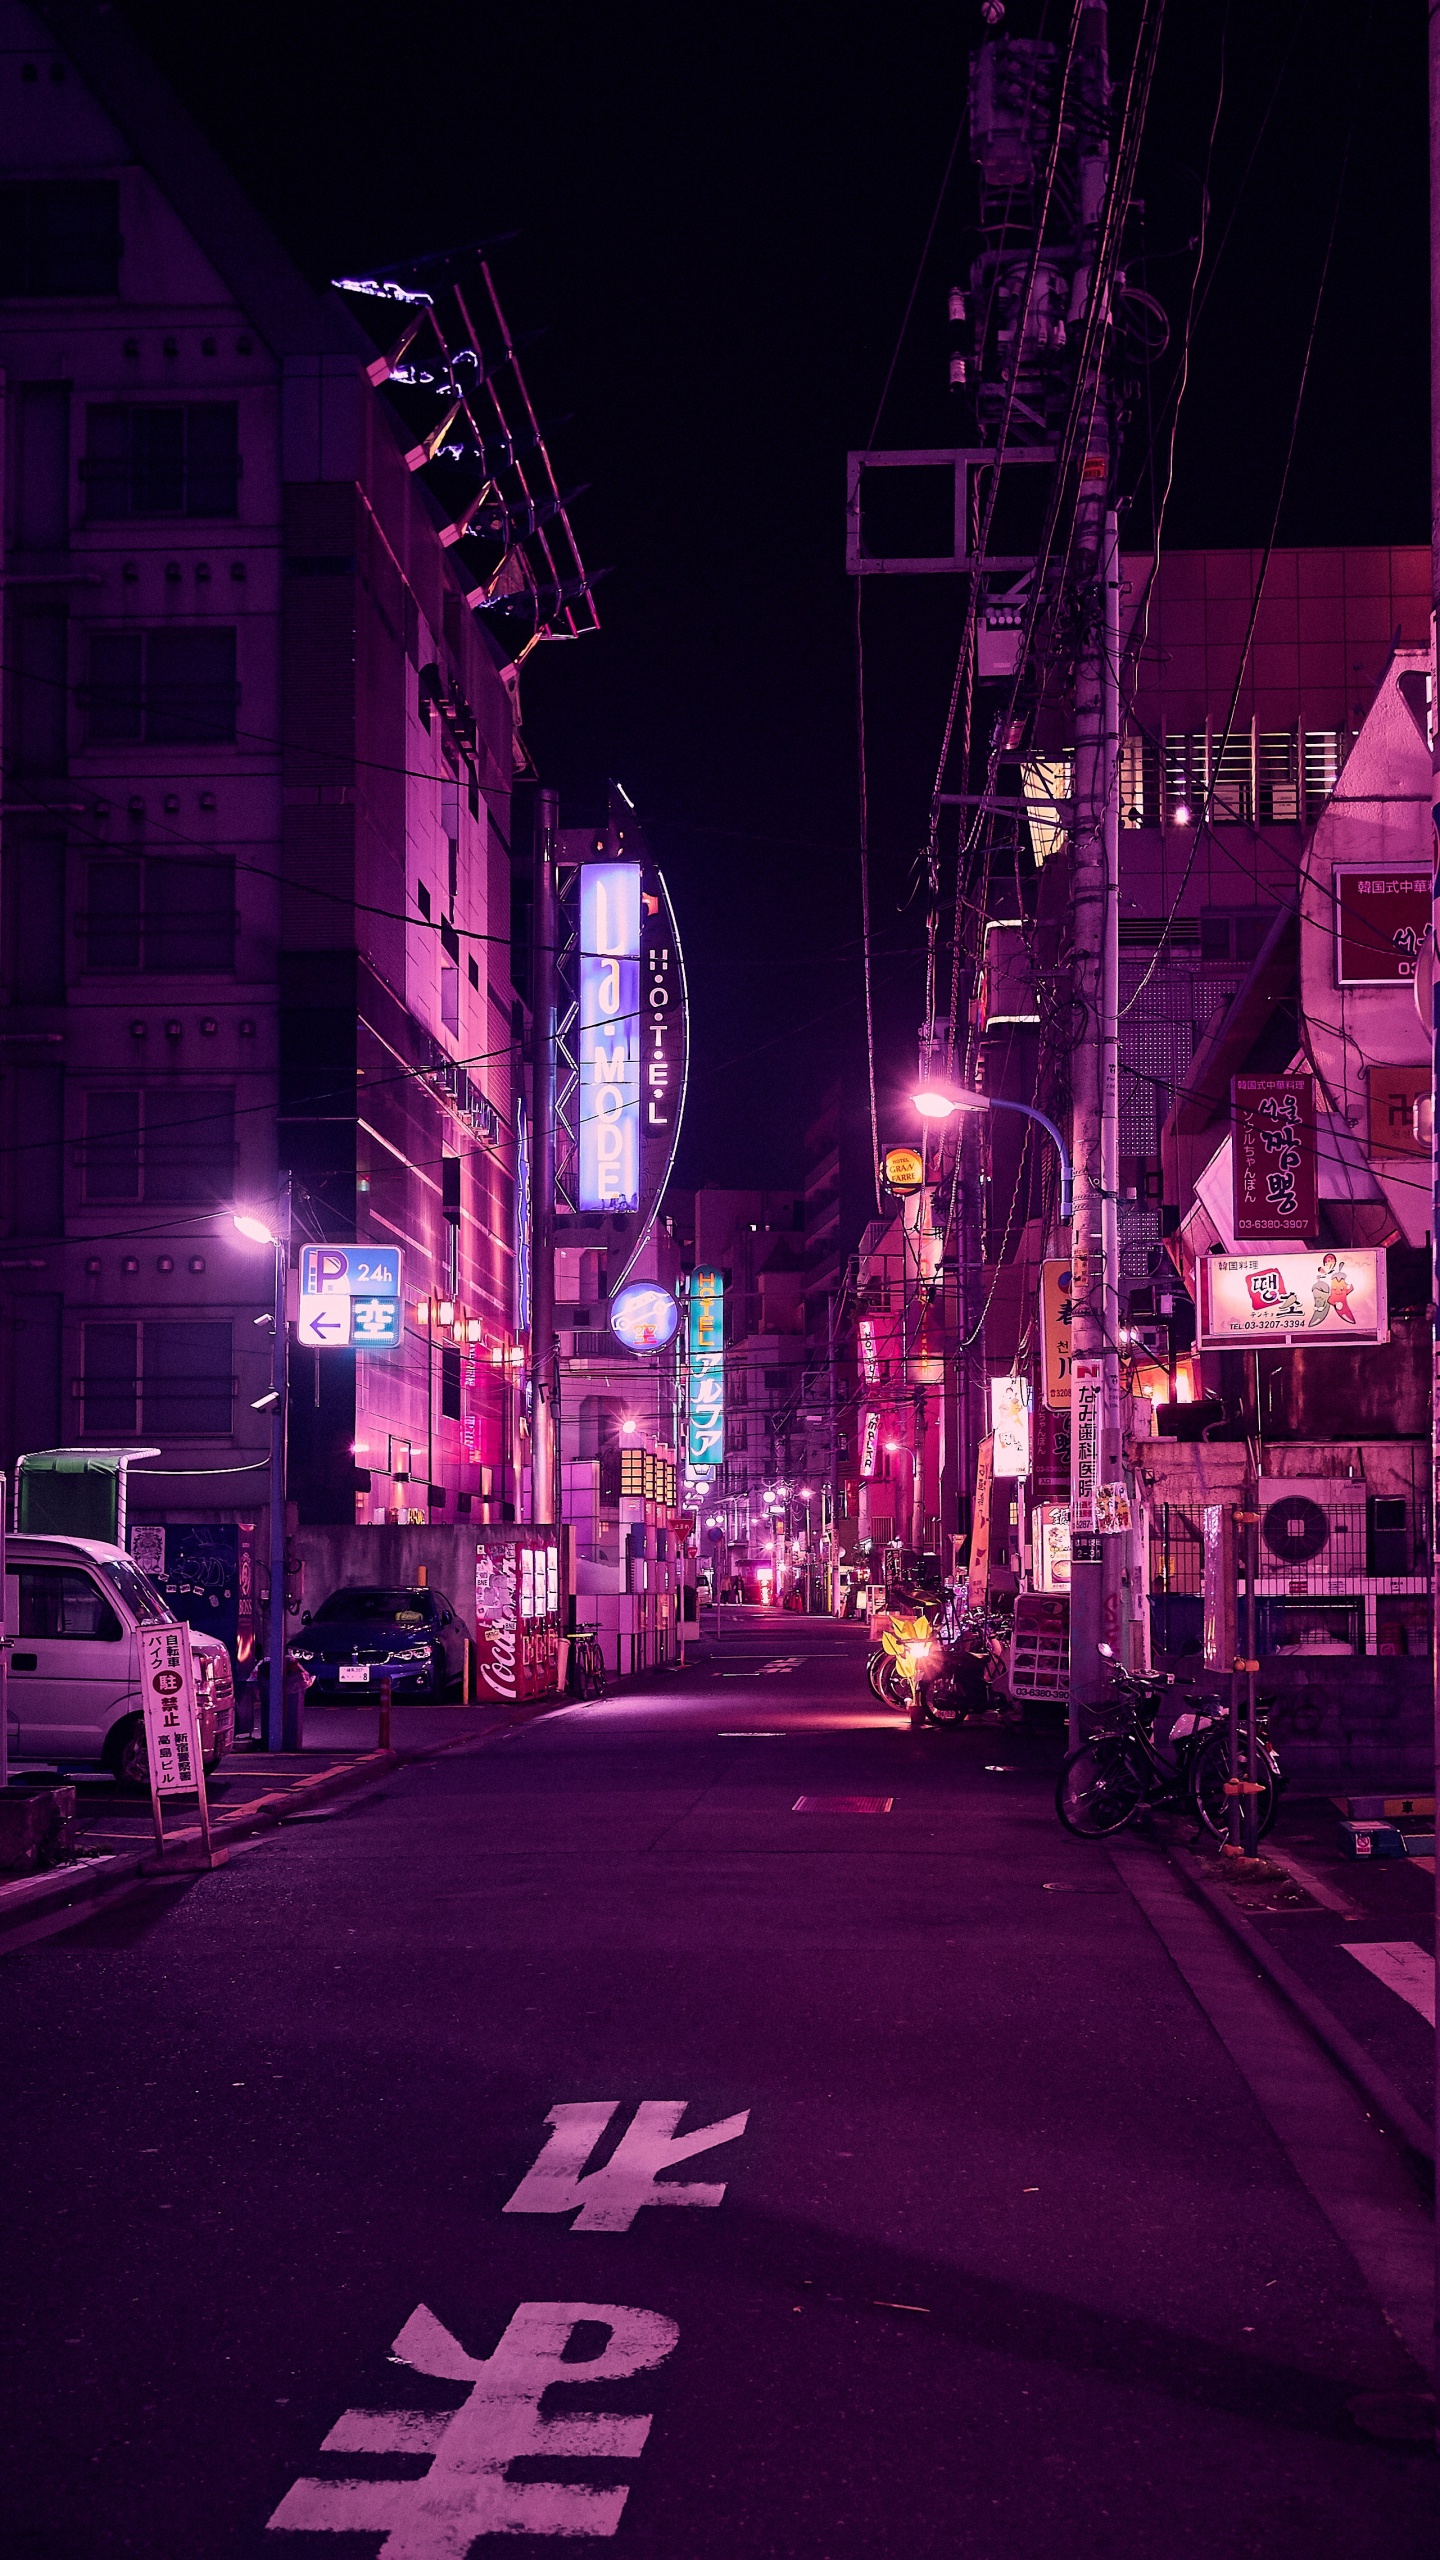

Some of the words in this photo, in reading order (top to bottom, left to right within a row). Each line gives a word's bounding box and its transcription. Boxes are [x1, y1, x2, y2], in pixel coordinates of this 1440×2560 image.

[1237, 1081, 1305, 1091] 韓国式中華料理
[1258, 1094, 1303, 1123] 서울
[1238, 1220, 1309, 1229] 03-6380-3907
[316, 1249, 348, 1293] P
[357, 1263, 393, 1282] 24h
[1218, 1260, 1259, 1271] 韓国料理
[354, 1299, 396, 1339] 空
[697, 1272, 715, 1346] HOTEL
[1078, 1385, 1097, 1498] なみ歯科医院
[148, 1636, 164, 1670] バイク
[166, 1634, 181, 1668] 自転車
[159, 1675, 178, 1691] 駐
[160, 1697, 181, 1728] 禁止
[157, 1734, 176, 1784] 高島ビル
